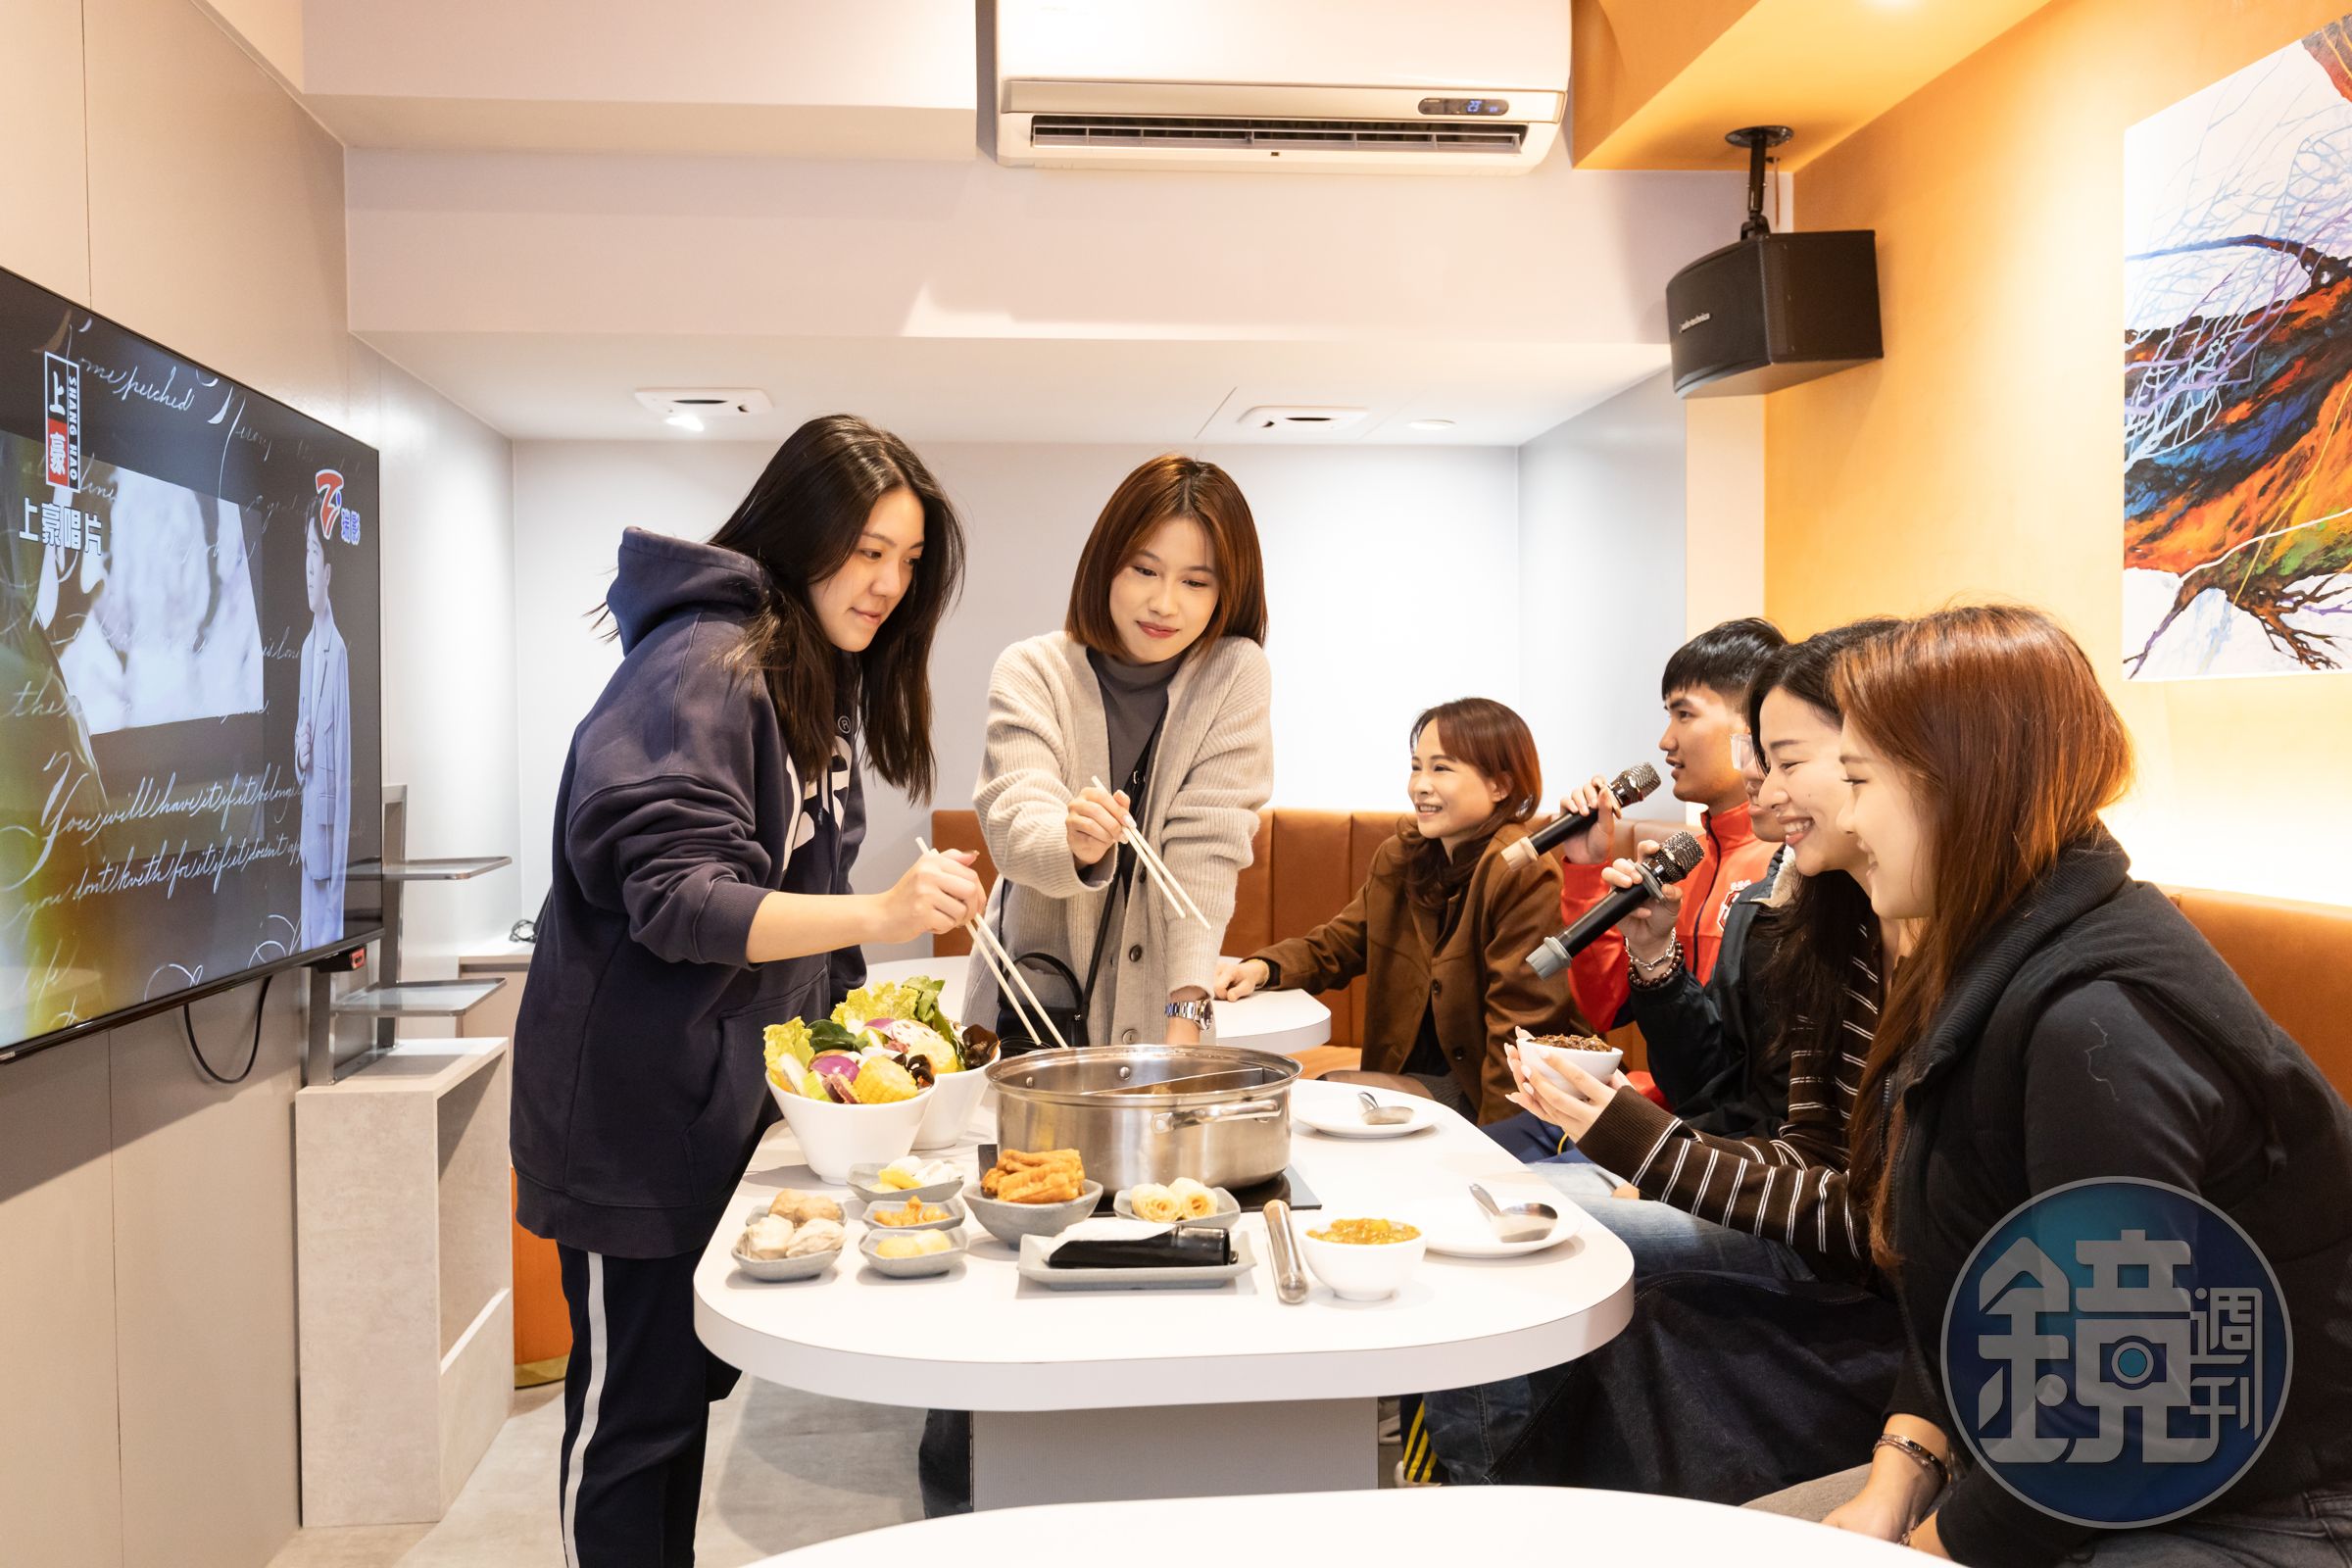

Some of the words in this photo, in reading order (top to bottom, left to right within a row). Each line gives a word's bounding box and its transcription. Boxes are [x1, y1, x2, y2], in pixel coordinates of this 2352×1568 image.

[68, 375, 77, 437] SHANG
[69, 445, 78, 482] HAO
[19, 497, 102, 556] 上豪唱片
